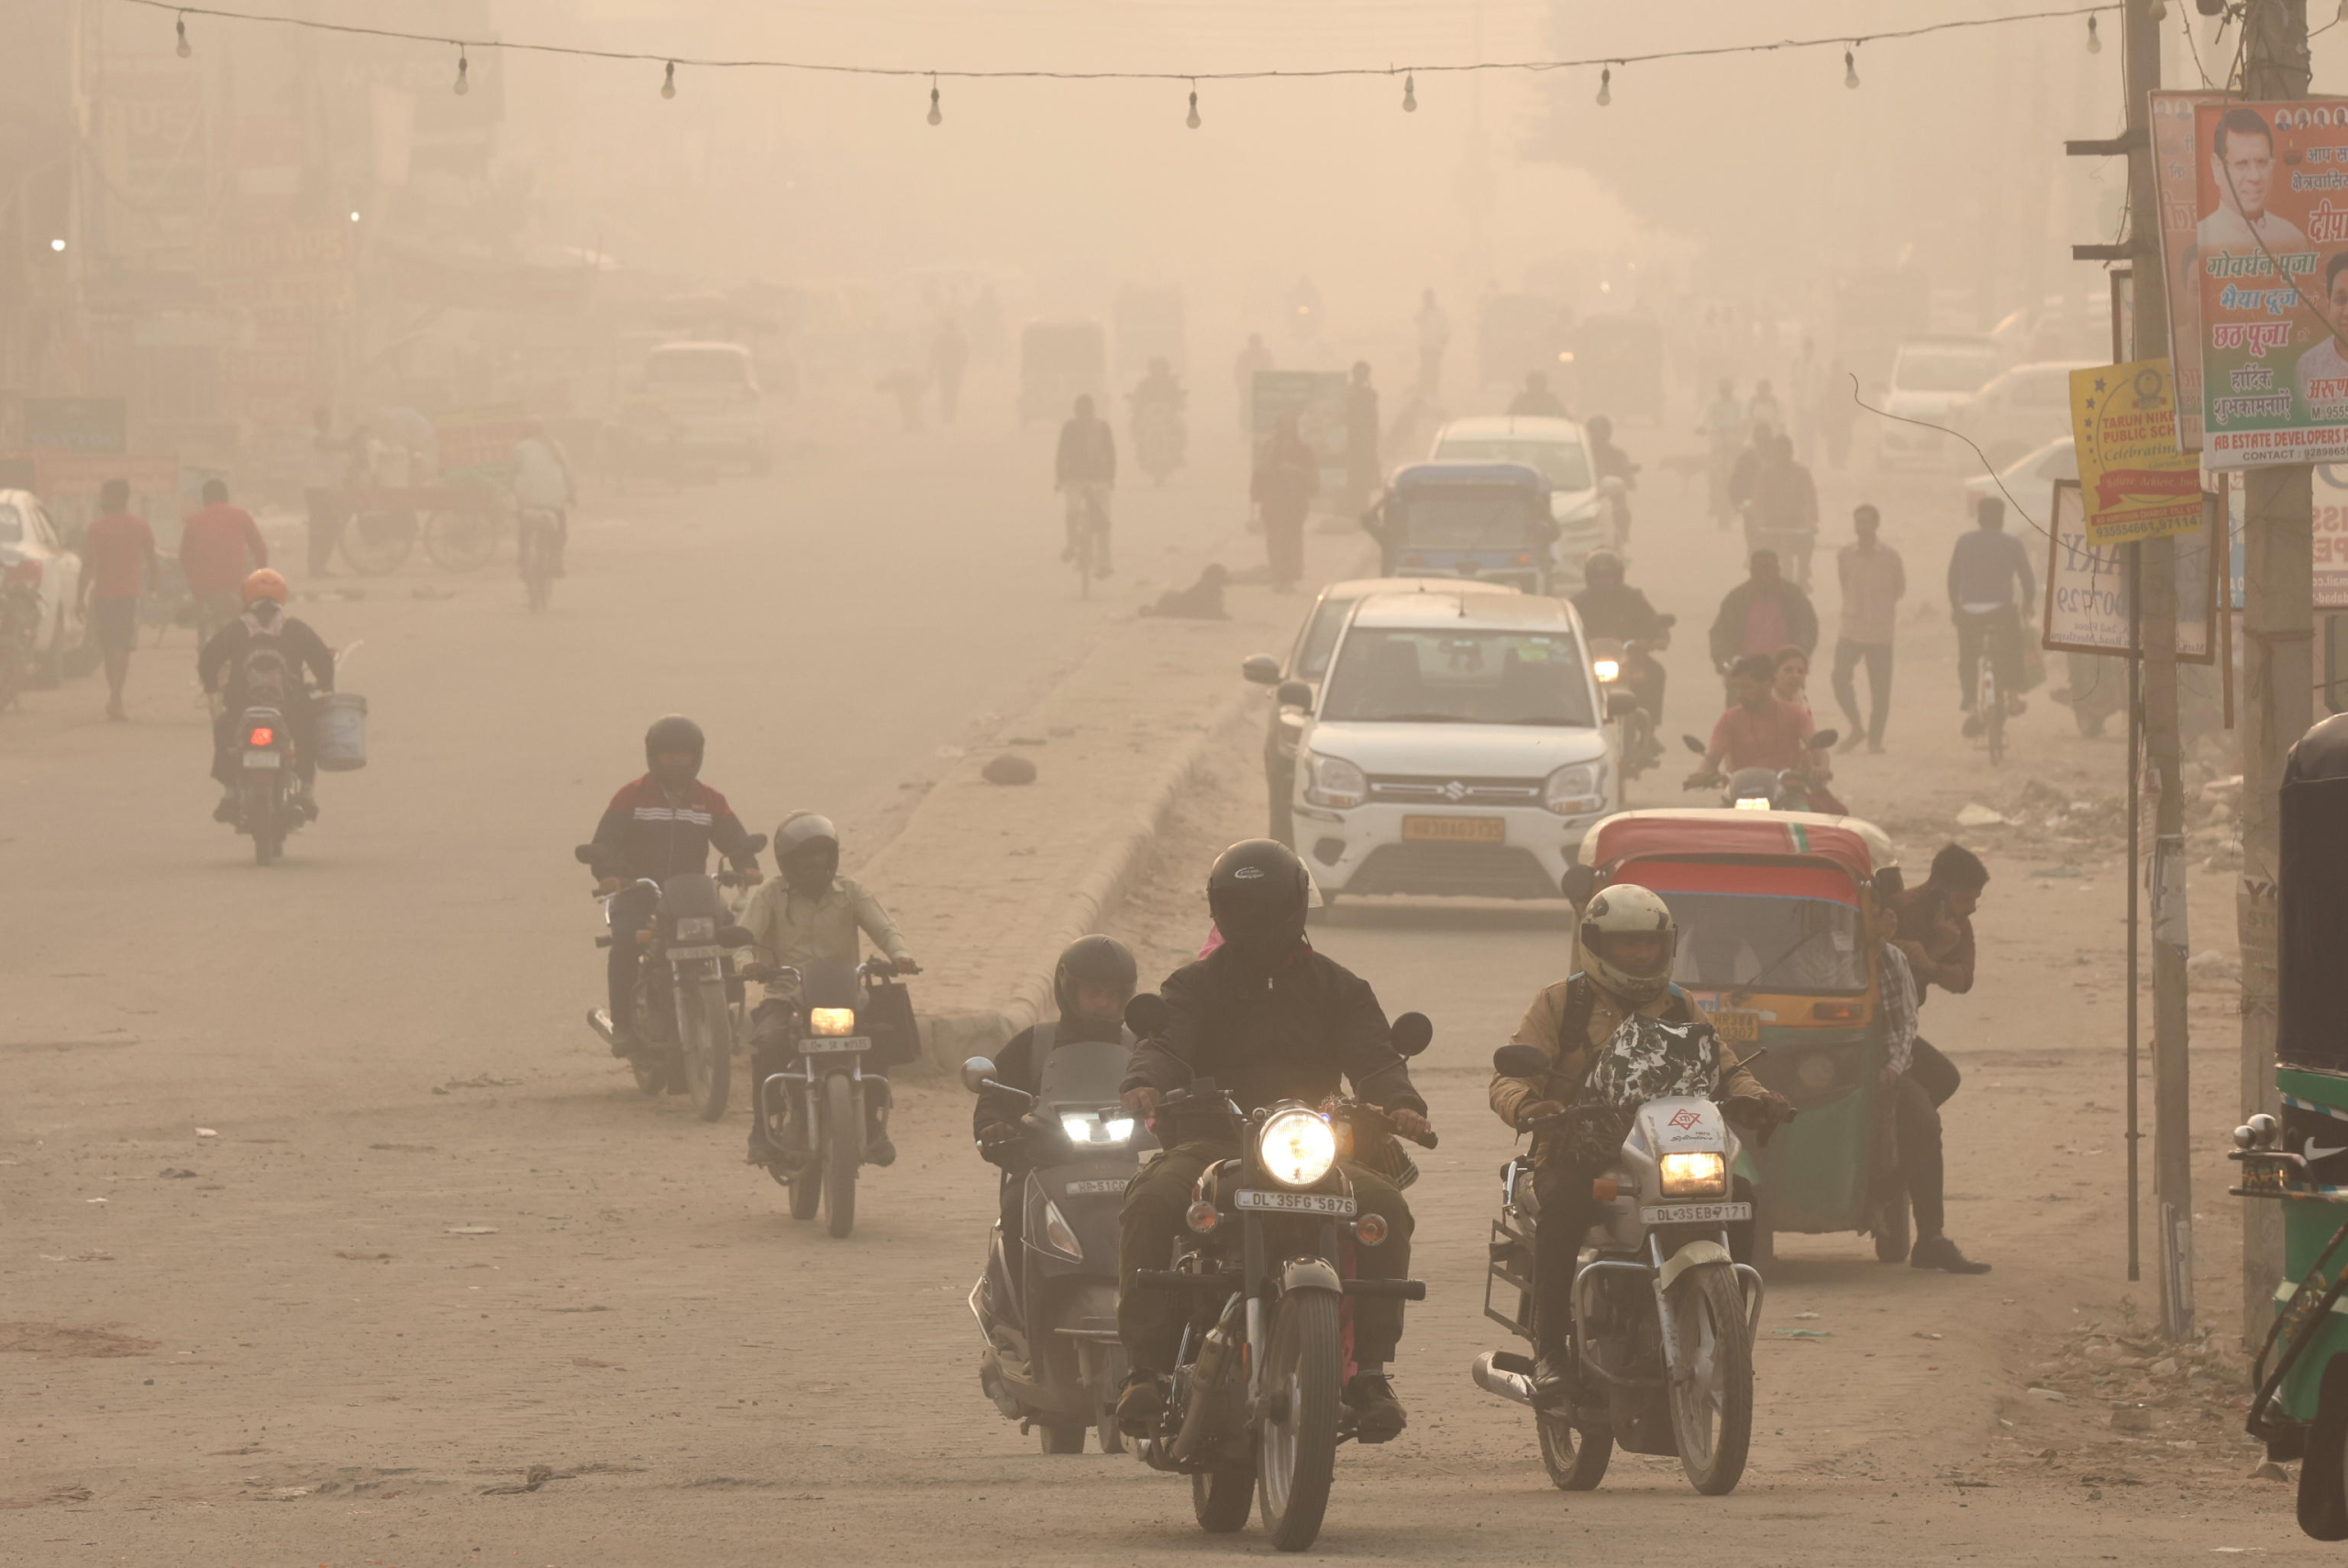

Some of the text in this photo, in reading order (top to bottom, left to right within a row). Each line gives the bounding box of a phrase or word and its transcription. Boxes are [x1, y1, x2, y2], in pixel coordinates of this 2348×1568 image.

[2220, 283, 2263, 309] भैया
[2213, 322, 2245, 349] छठ
[2247, 320, 2293, 358] पूजा
[2102, 409, 2175, 429] TARUN NIKE
[2103, 427, 2146, 444] PUBLIC
[2151, 423, 2176, 437] SCH
[2214, 435, 2229, 452] AB
[2232, 431, 2271, 449] ESTATE
[2275, 428, 2341, 447] DEVELOPERS
[2104, 444, 2178, 462] Celebrating
[2243, 449, 2295, 460] CONTACT
[2170, 505, 2185, 514] TILL
[1253, 1193, 1352, 1212] DL 3SFG 5876
